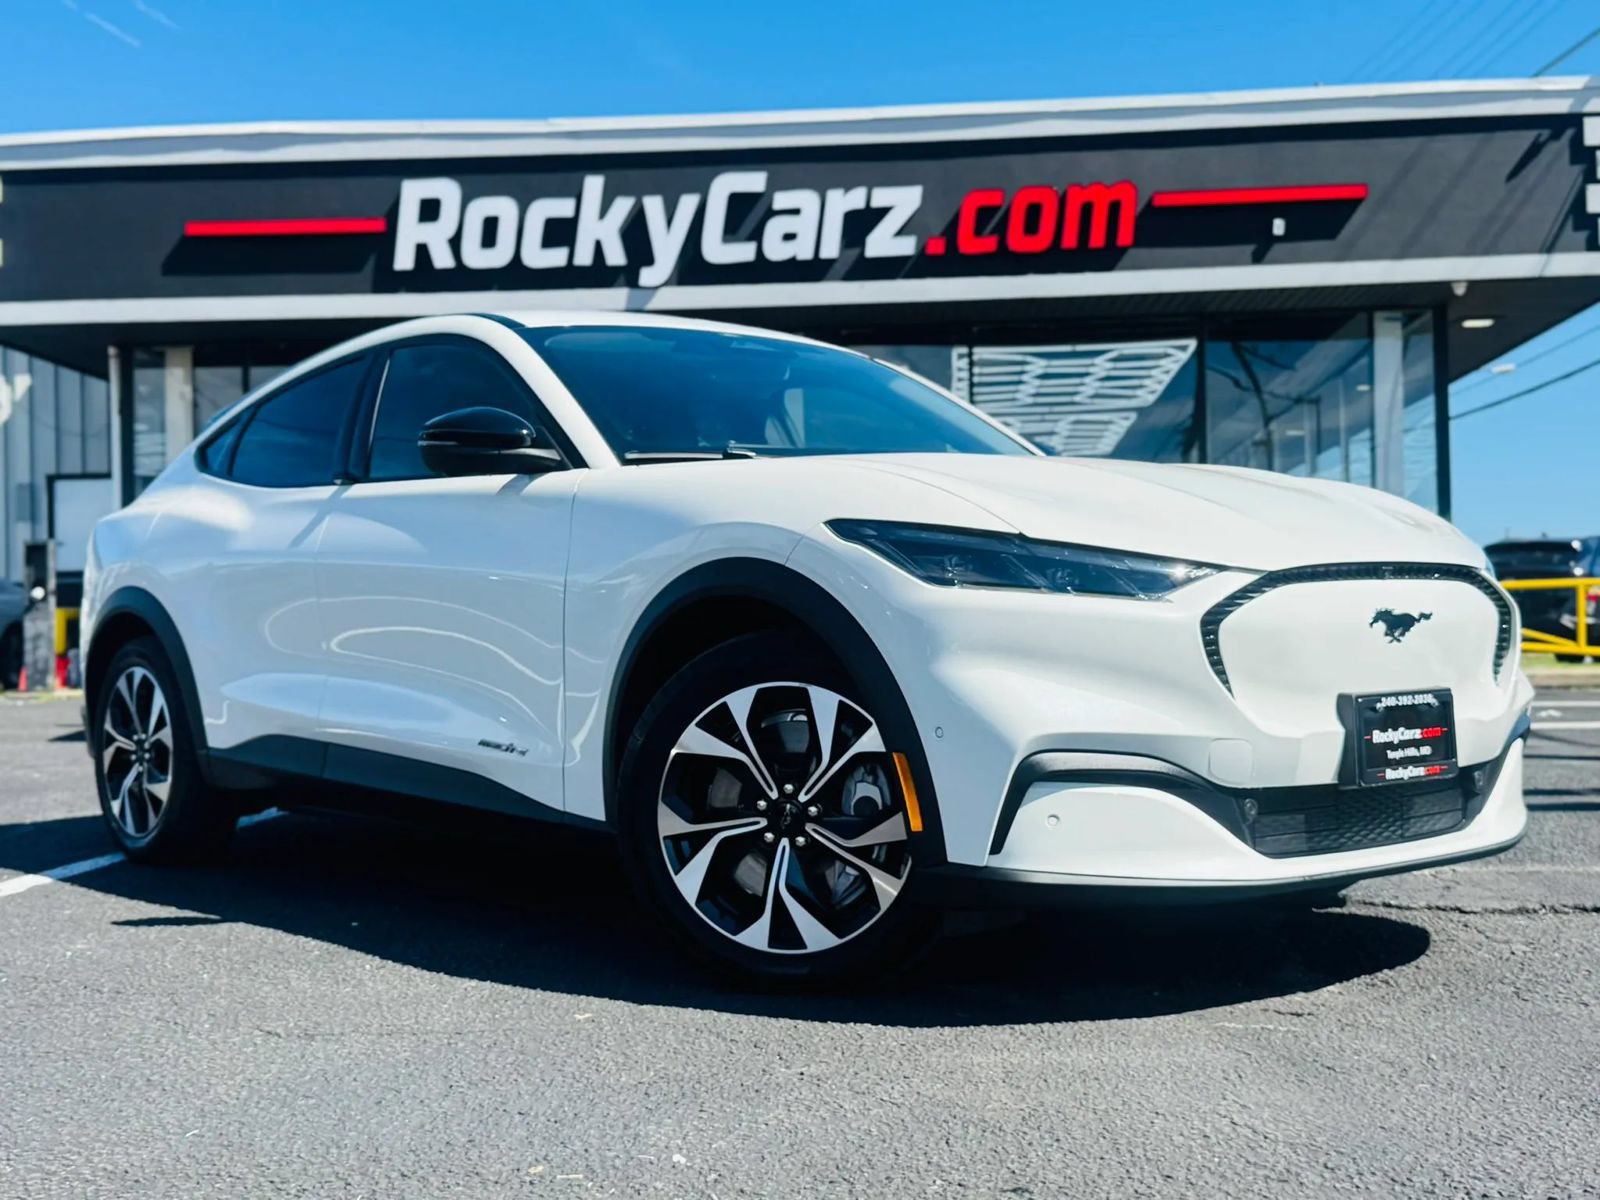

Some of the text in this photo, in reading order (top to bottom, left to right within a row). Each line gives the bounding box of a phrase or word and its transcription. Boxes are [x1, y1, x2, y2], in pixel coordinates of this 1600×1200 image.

[393, 171, 1138, 288] RockyCarz.com
[1372, 727, 1441, 744] RockyCarz.com
[1385, 765, 1440, 780] RockyCarz.com
